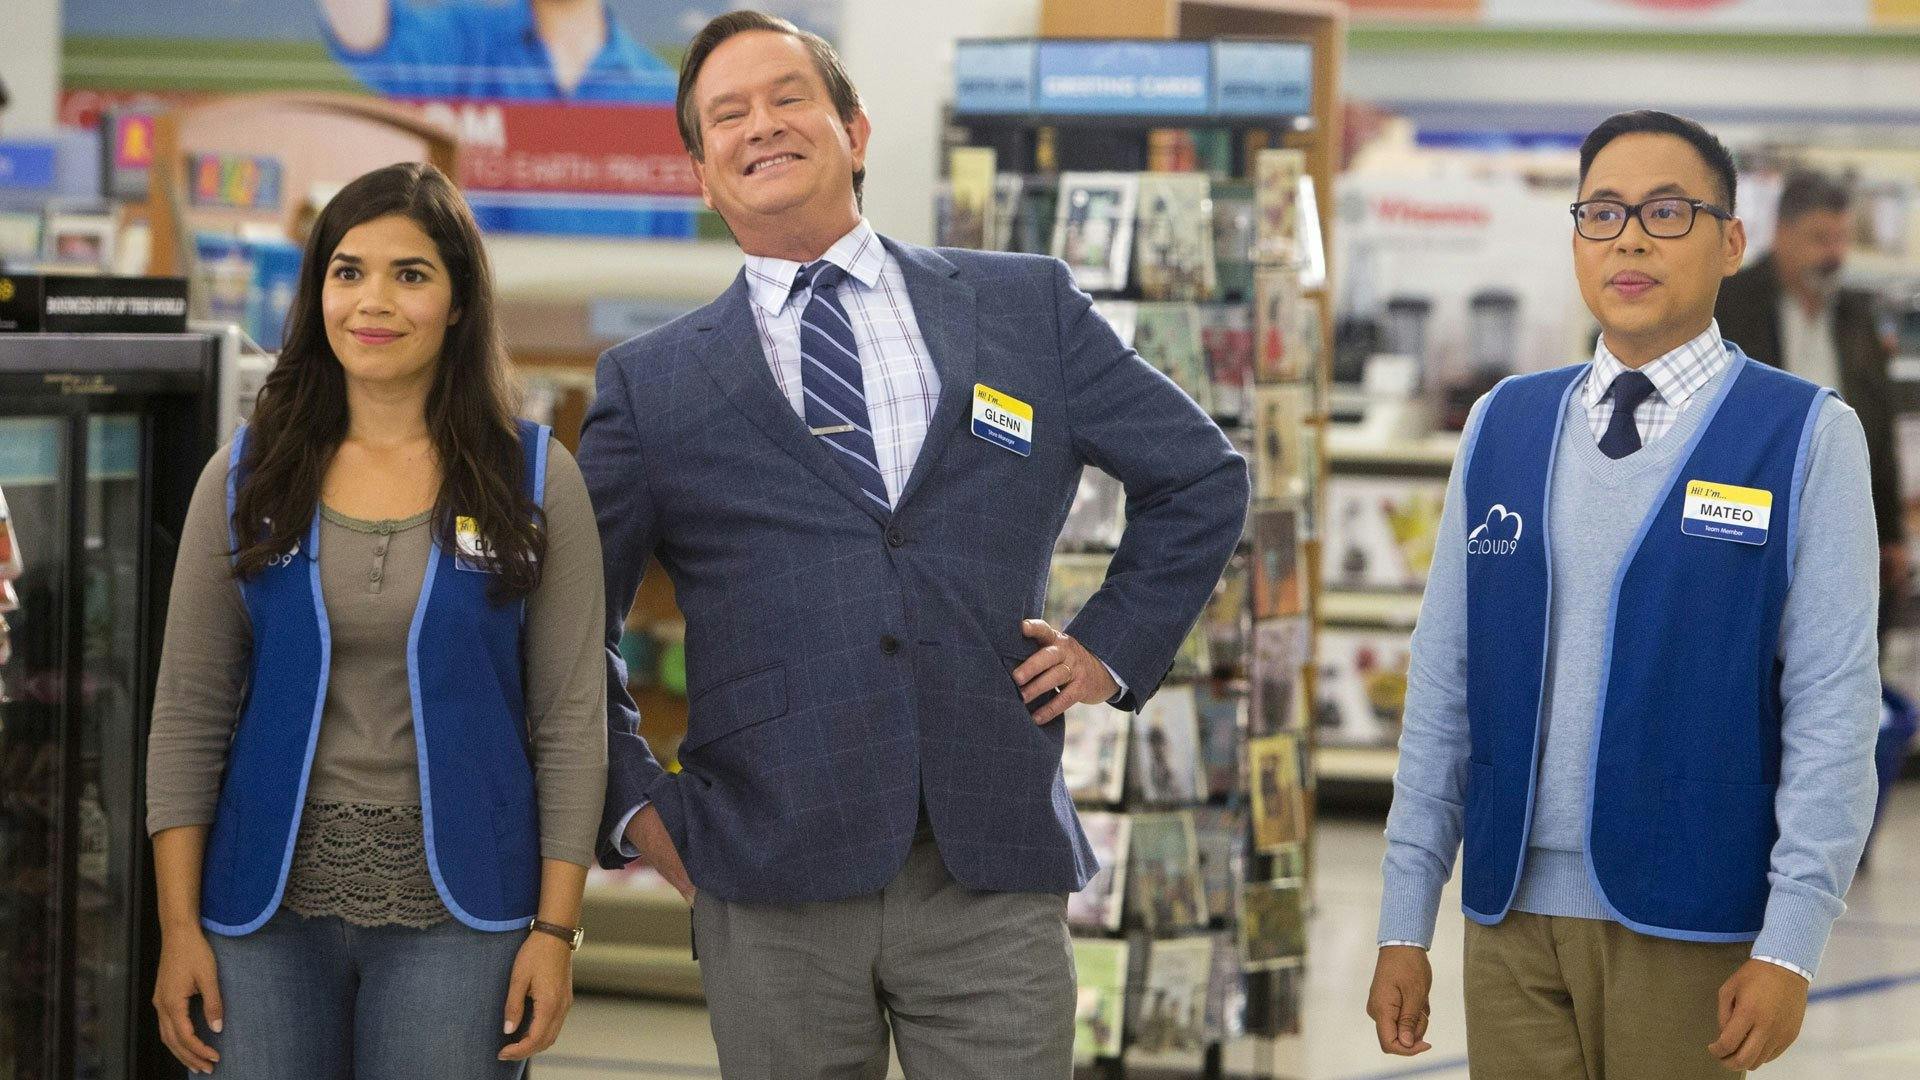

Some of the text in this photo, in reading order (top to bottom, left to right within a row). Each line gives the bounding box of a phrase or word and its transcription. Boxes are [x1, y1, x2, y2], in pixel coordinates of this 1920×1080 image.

[984, 408, 1021, 433] GLENN
[1690, 486, 1704, 496] Hi!
[1700, 503, 1754, 522] MATEO
[1705, 525, 1744, 537] Team Member
[1467, 539, 1517, 555] CLOUD9
